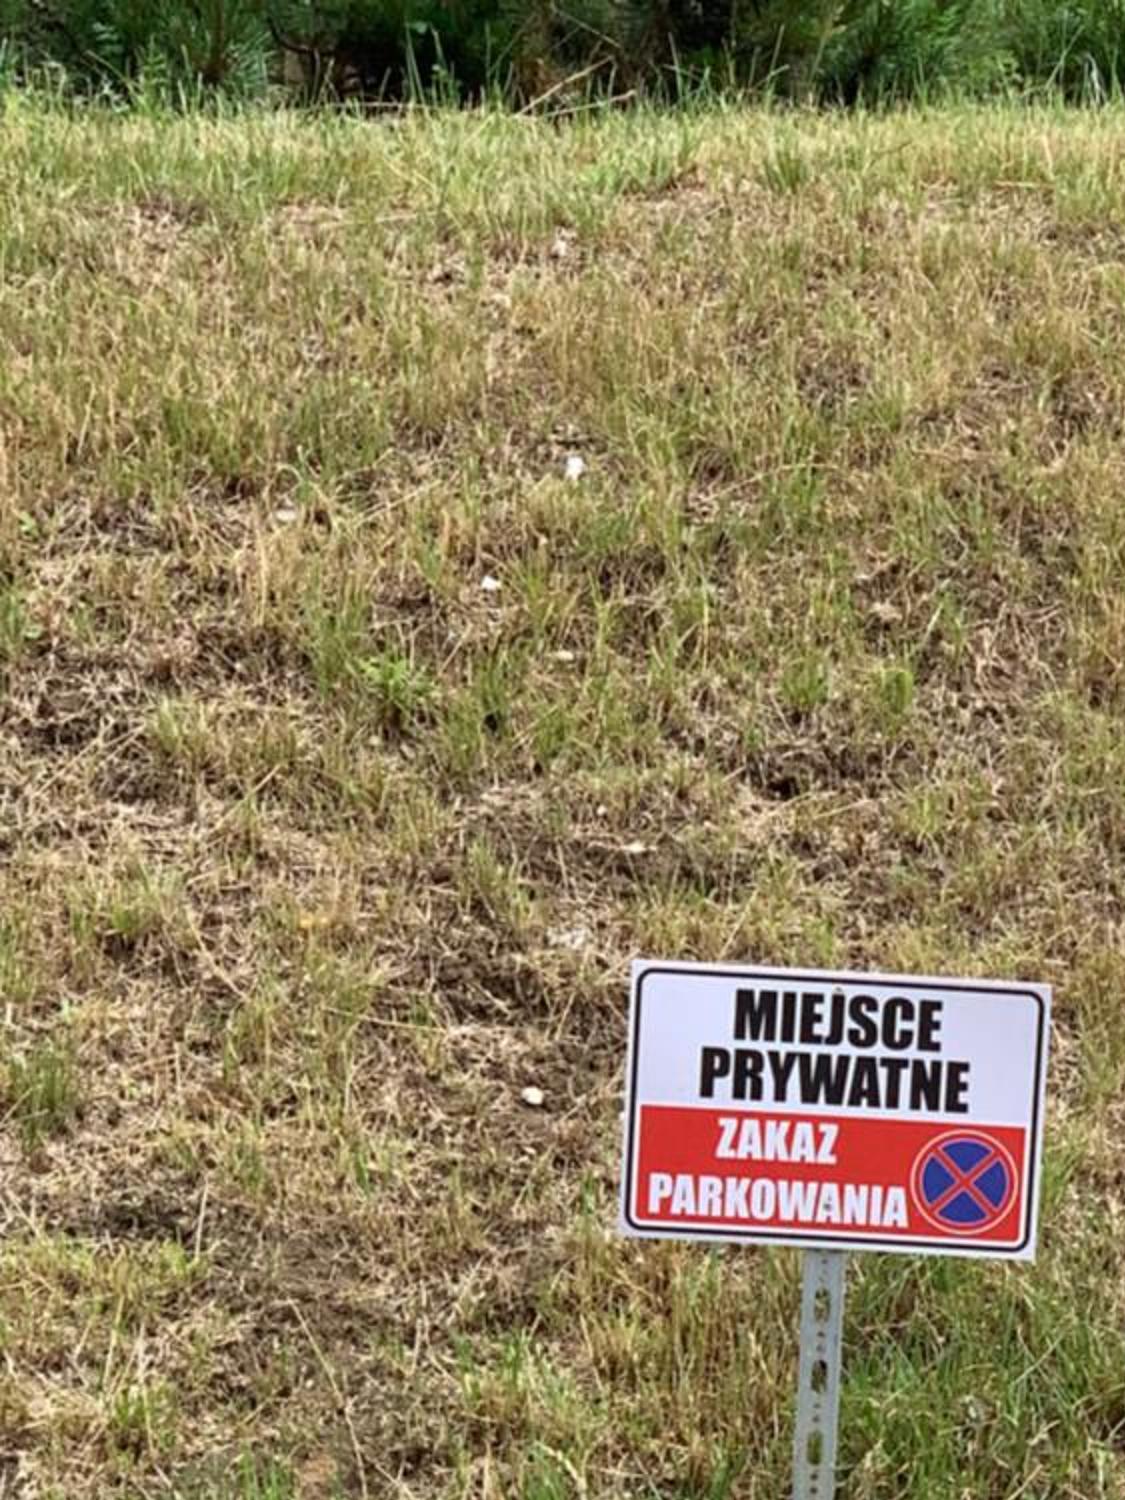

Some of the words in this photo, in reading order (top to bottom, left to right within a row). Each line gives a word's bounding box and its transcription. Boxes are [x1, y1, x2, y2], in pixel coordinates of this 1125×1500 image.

[734, 988, 943, 1052] MIEJSCE
[699, 1046, 970, 1113] PRYWATNE
[715, 1118, 839, 1165] ZAKAZ
[648, 1174, 908, 1228] PARKOWANIA
